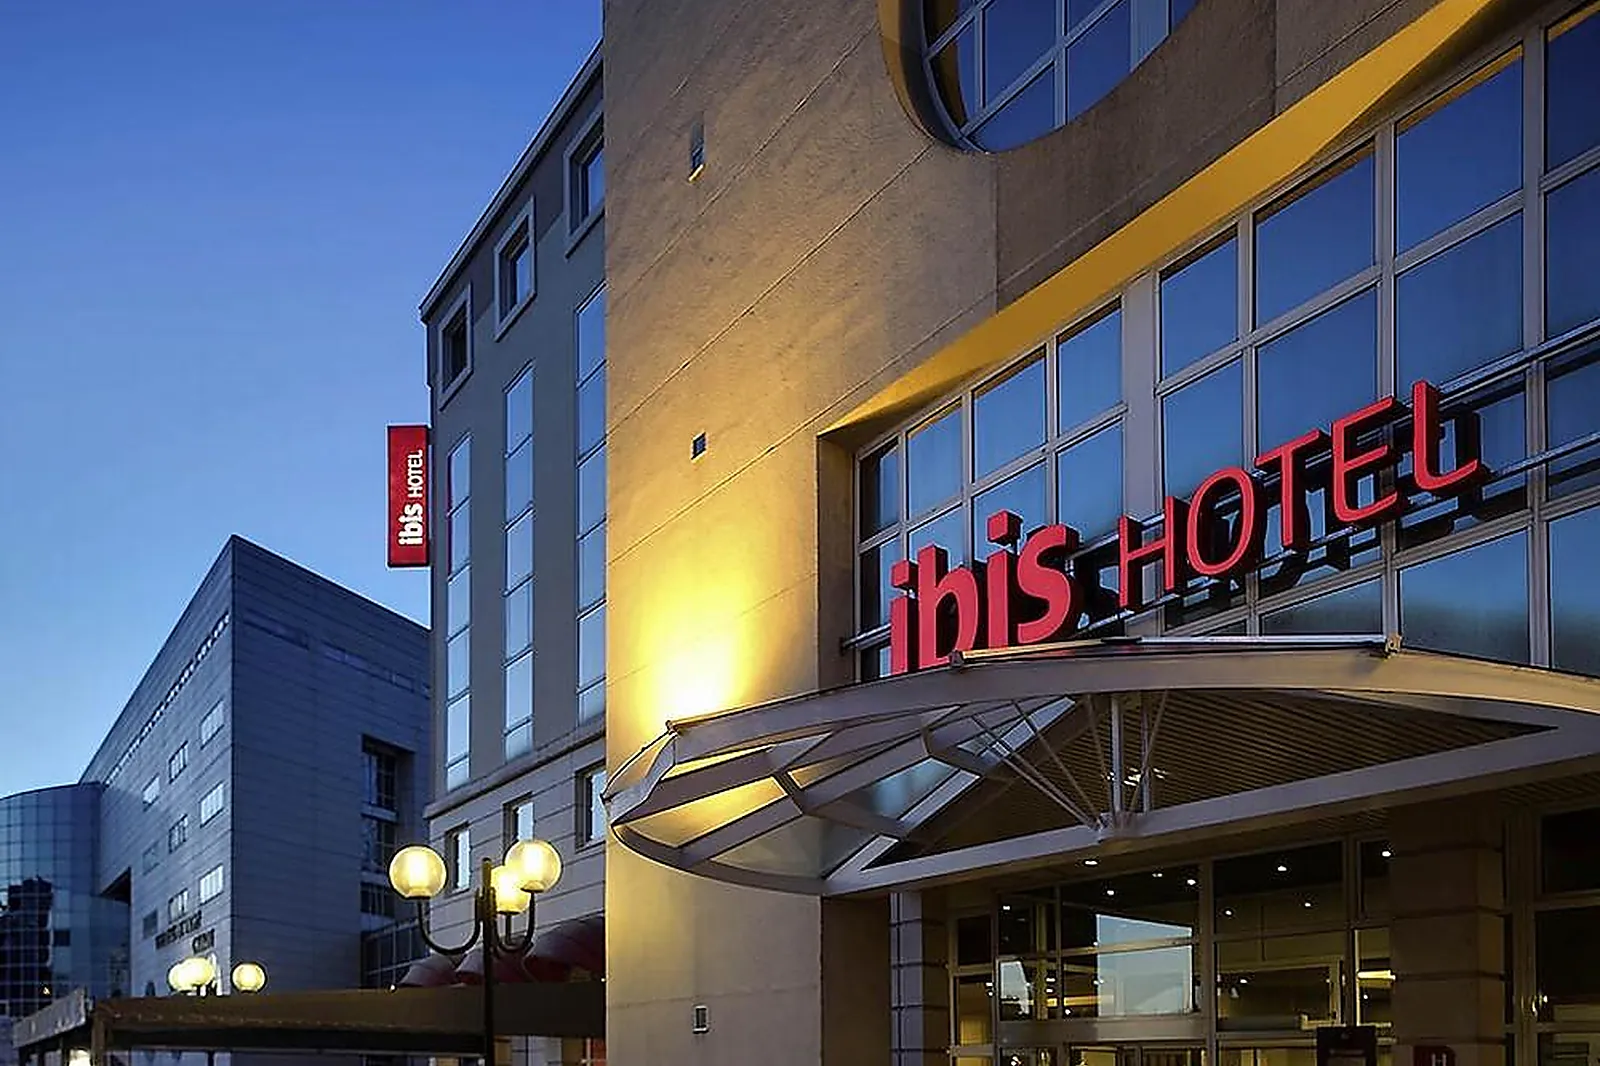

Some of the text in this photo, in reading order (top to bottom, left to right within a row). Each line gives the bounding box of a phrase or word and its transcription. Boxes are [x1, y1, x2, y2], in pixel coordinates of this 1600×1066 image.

[398, 449, 424, 545] ibis HOTEL
[890, 380, 1479, 675] ibis HOTEL
